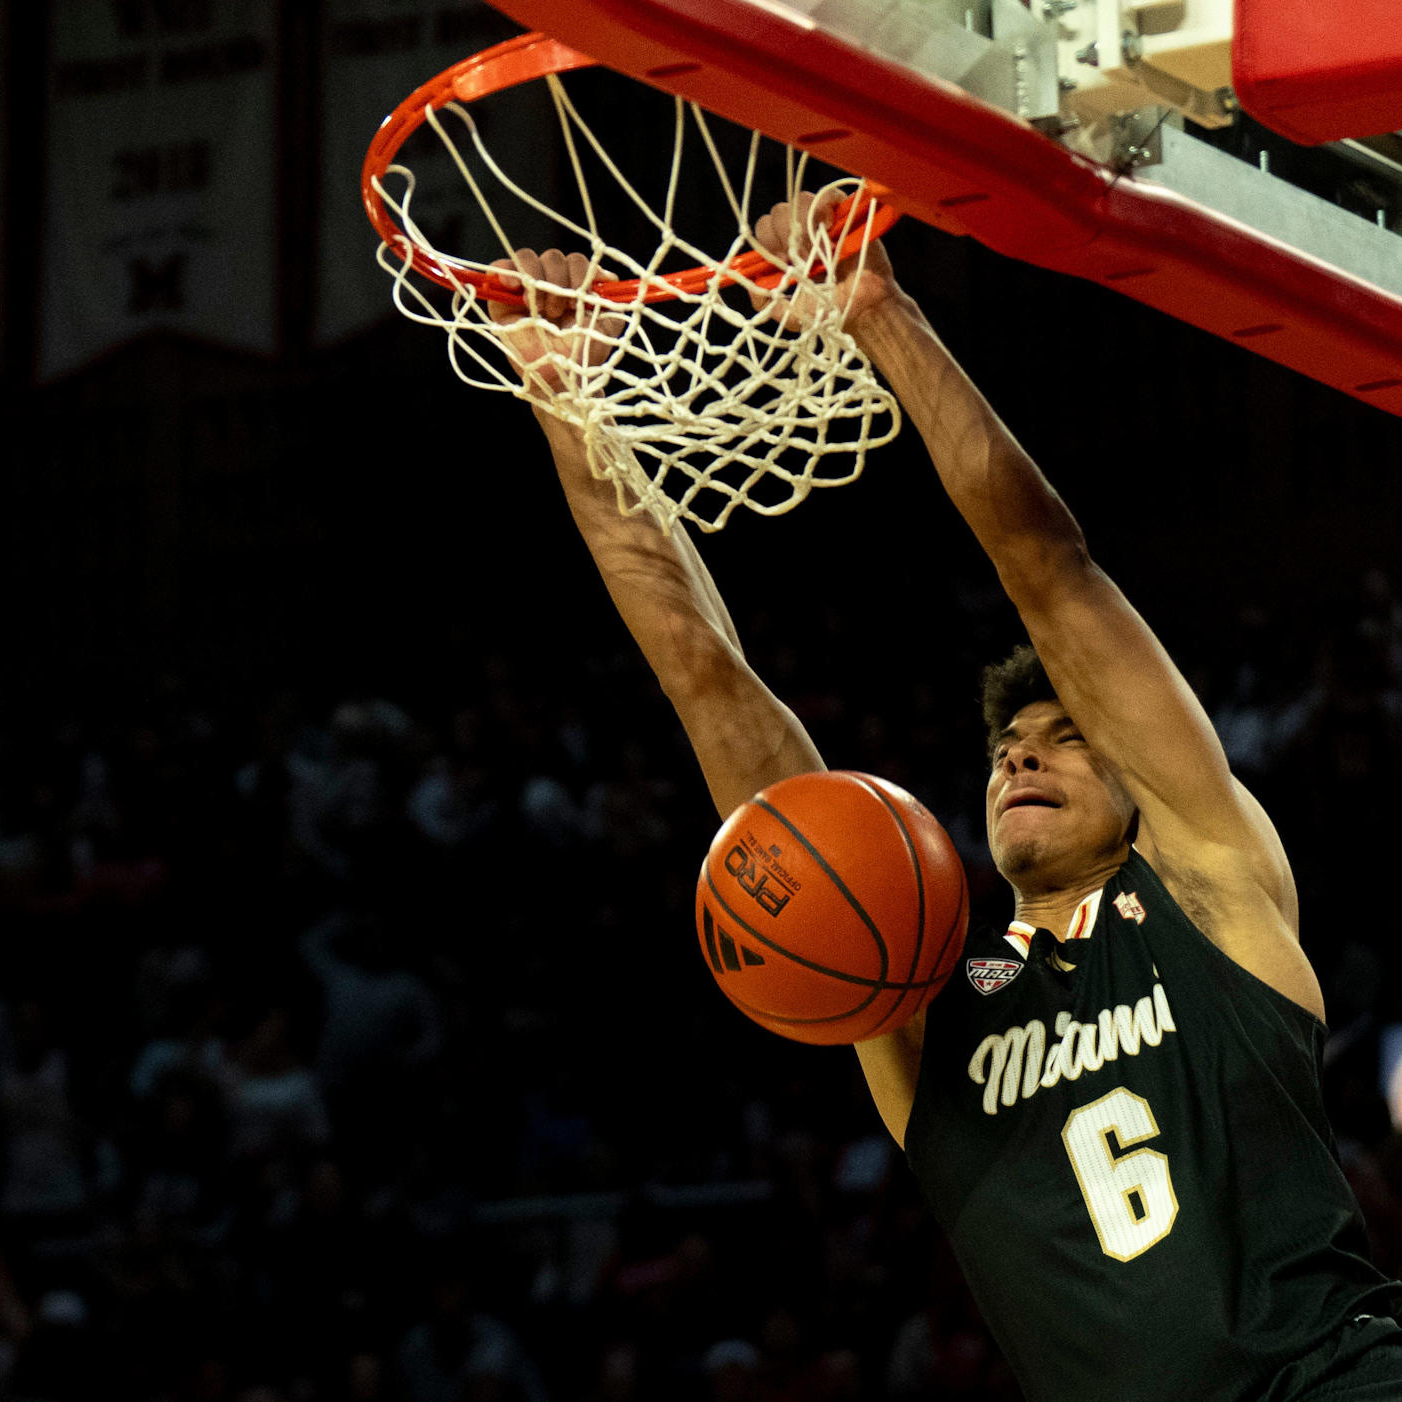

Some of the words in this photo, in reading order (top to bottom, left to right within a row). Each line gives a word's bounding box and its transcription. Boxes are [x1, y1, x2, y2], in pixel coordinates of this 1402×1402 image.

[725, 845, 791, 918] PRO
[968, 967, 1016, 979] MAC
[968, 962, 1177, 1115] Miami
[1061, 1086, 1179, 1263] 6
